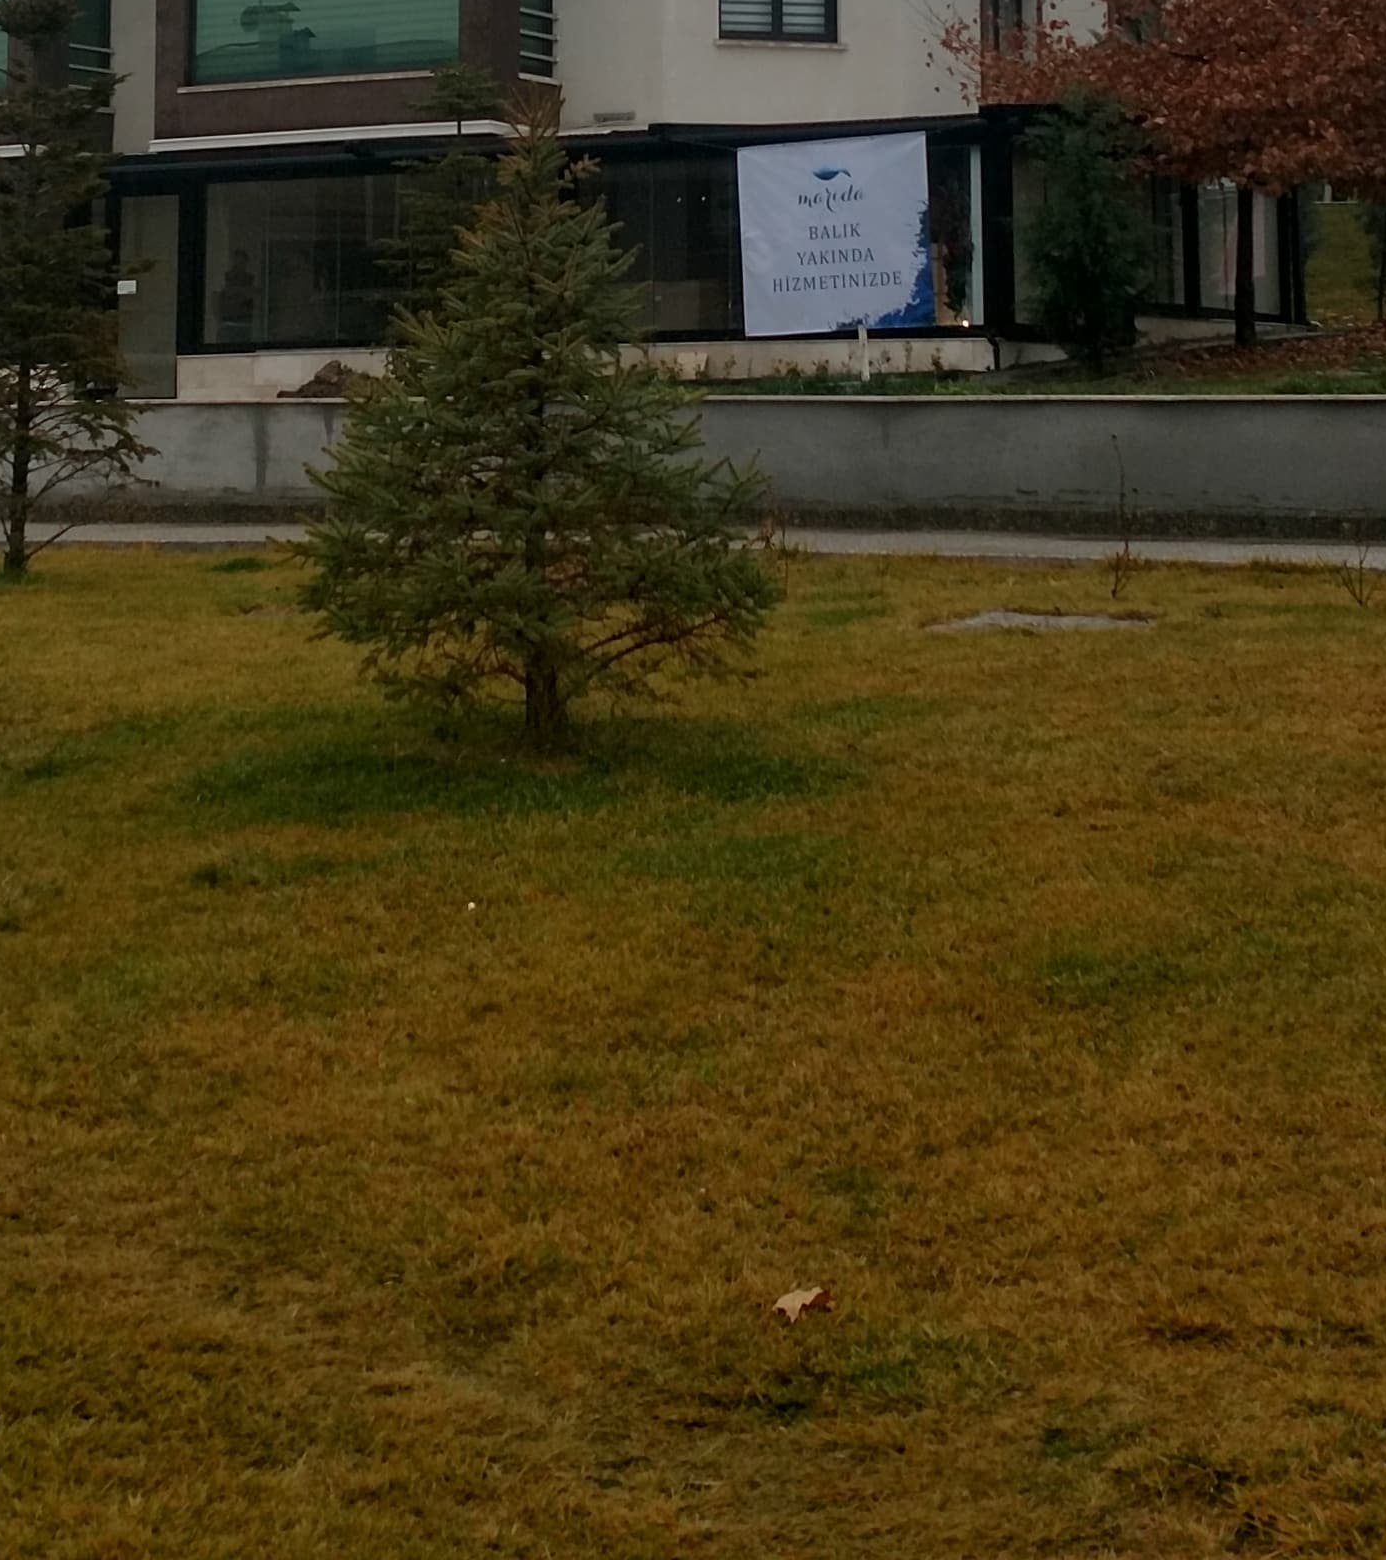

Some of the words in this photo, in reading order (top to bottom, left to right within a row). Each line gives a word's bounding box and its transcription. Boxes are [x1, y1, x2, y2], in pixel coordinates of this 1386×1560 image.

[808, 223, 861, 240] BALIK
[797, 247, 875, 266] YAKINDA
[773, 270, 902, 293] HİZMETİNİZDE
